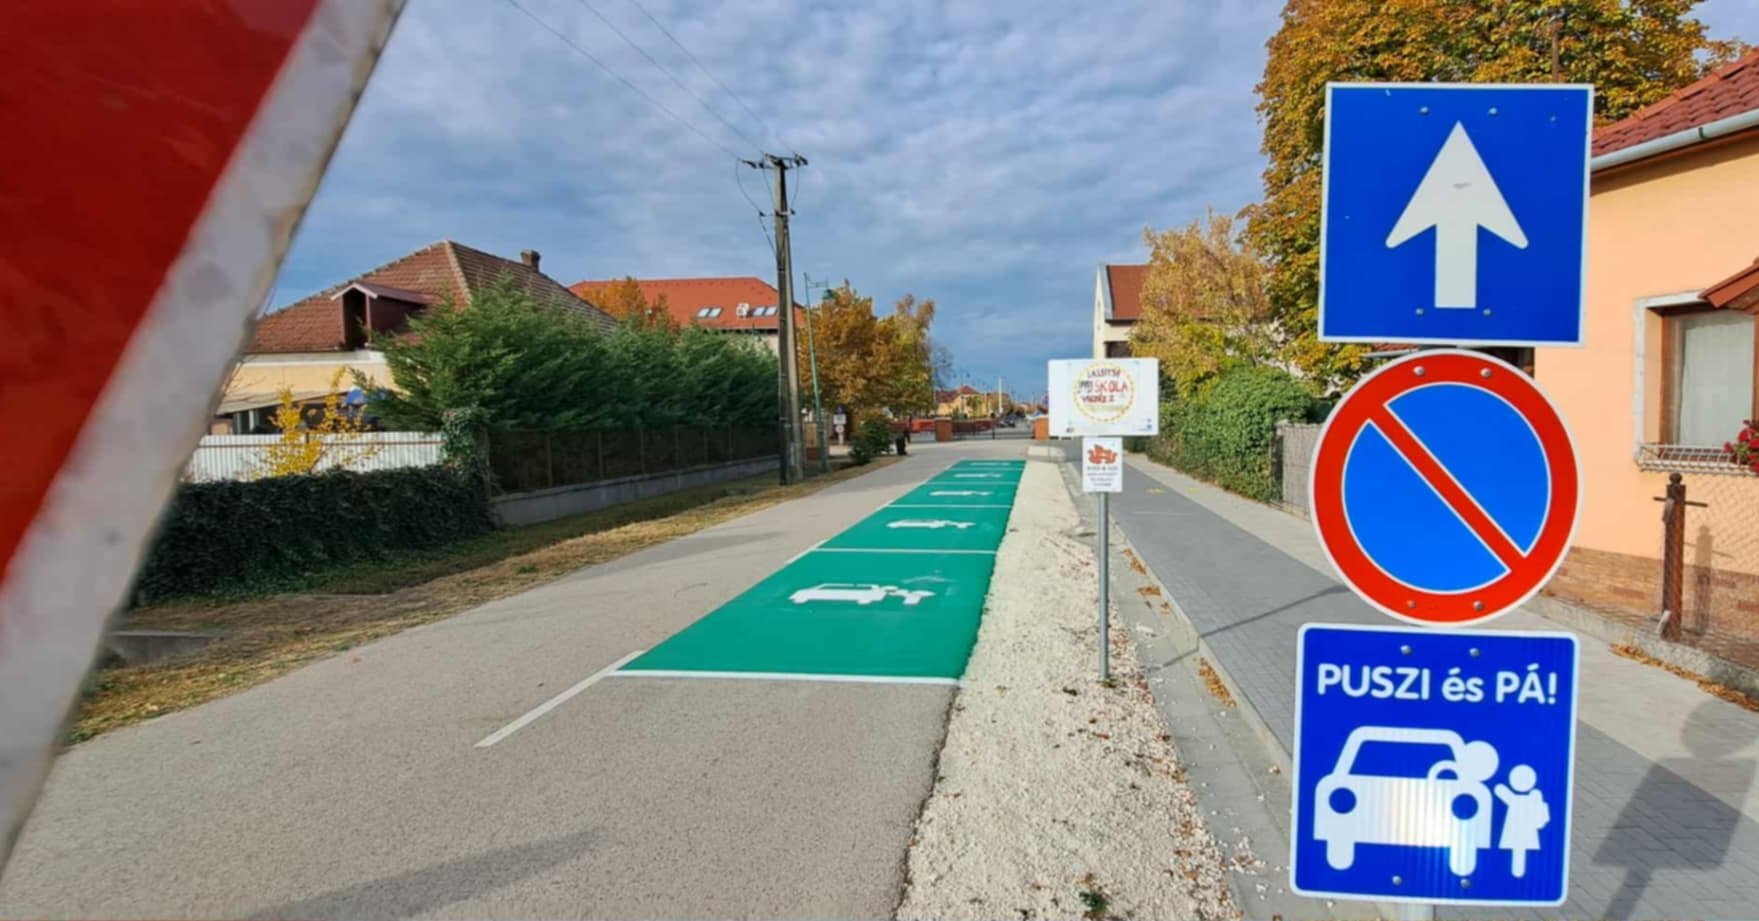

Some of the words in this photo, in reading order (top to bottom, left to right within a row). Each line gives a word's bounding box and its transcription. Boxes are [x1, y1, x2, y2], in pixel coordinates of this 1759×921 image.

[1317, 663, 1431, 701] PUSZI
[1441, 667, 1485, 702] és
[1495, 663, 1558, 705] PÁ!
